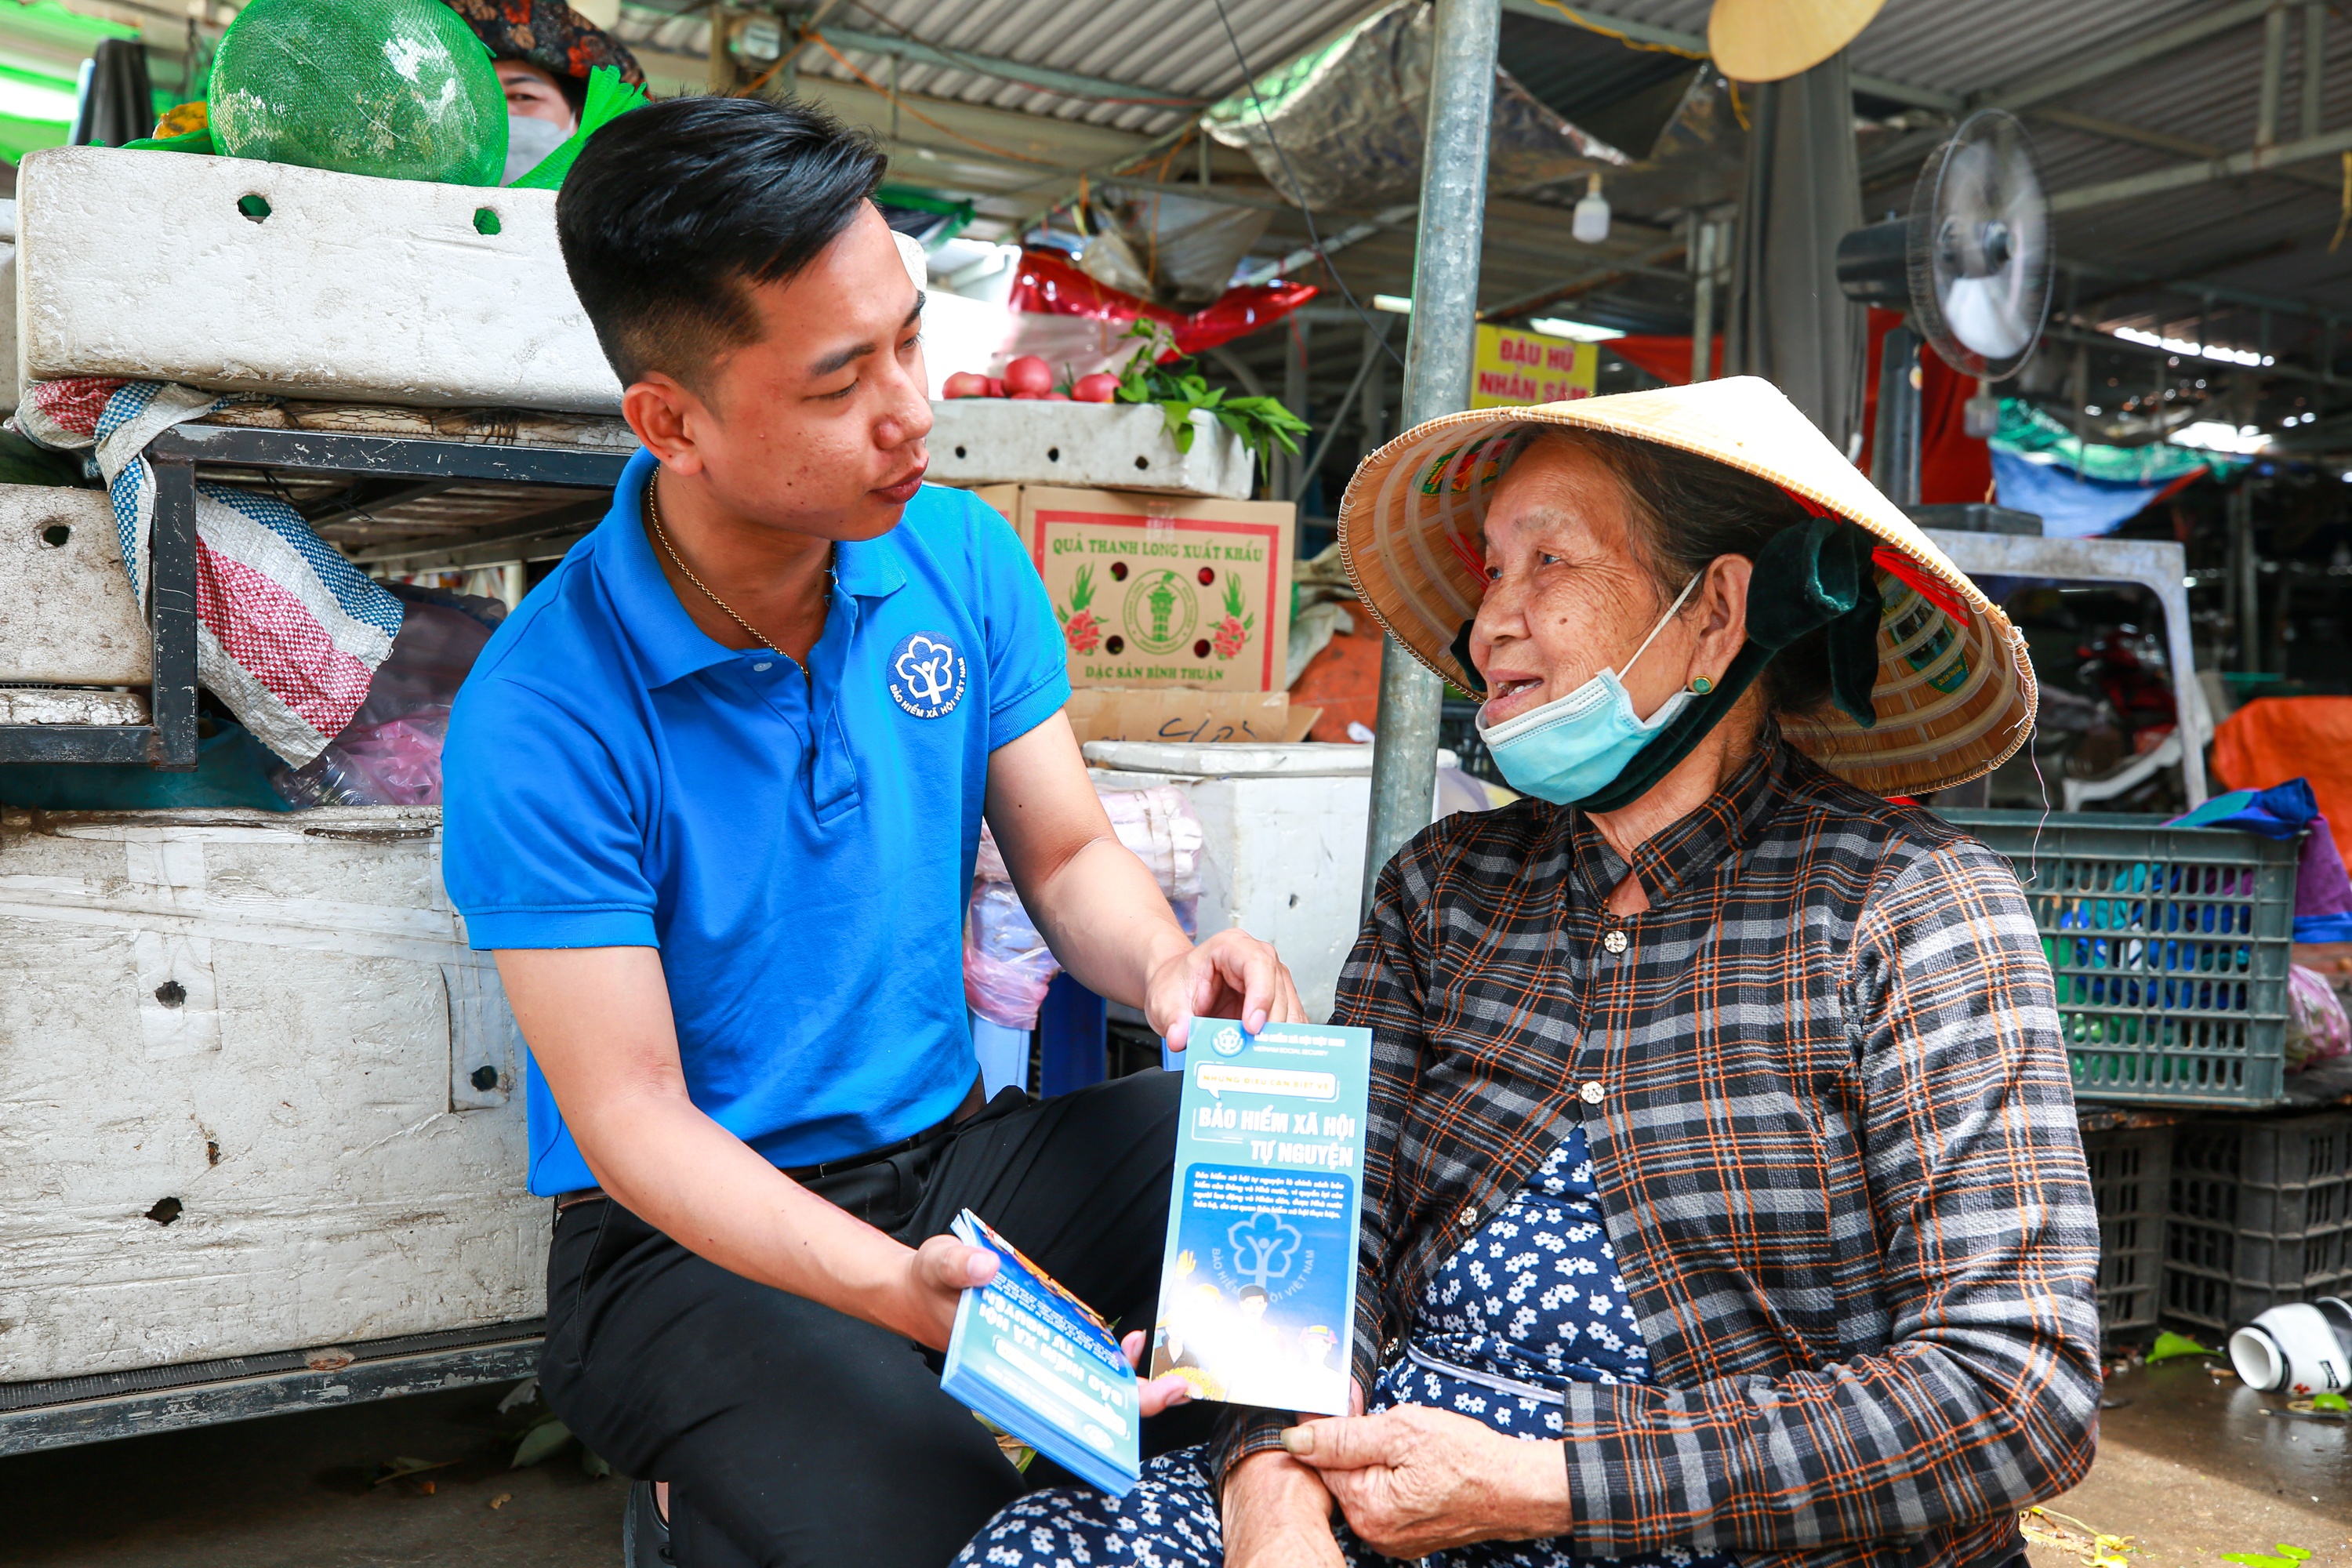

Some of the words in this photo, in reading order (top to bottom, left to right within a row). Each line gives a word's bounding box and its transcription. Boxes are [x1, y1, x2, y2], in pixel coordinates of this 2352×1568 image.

[1479, 371, 1537, 401] NHÂN
[1089, 539, 1138, 554] THANH
[1142, 542, 1178, 558] LONG
[890, 684, 903, 702] BẢO
[927, 707, 938, 718] XÃ
[940, 699, 956, 714] HỘI
[953, 679, 965, 701] VIỆT
[1199, 1102, 1236, 1129] BẢO
[1241, 1105, 1289, 1133] HIỂM
[1293, 1112, 1319, 1135] XÃ
[1323, 1113, 1356, 1142] HỘI
[1250, 1140, 1276, 1165] TỰ
[1278, 1142, 1353, 1170] NGUYỆN
[1303, 1250, 1314, 1274] NAM
[979, 1303, 1010, 1332] HỘI
[1052, 1334, 1075, 1358] TỰ
